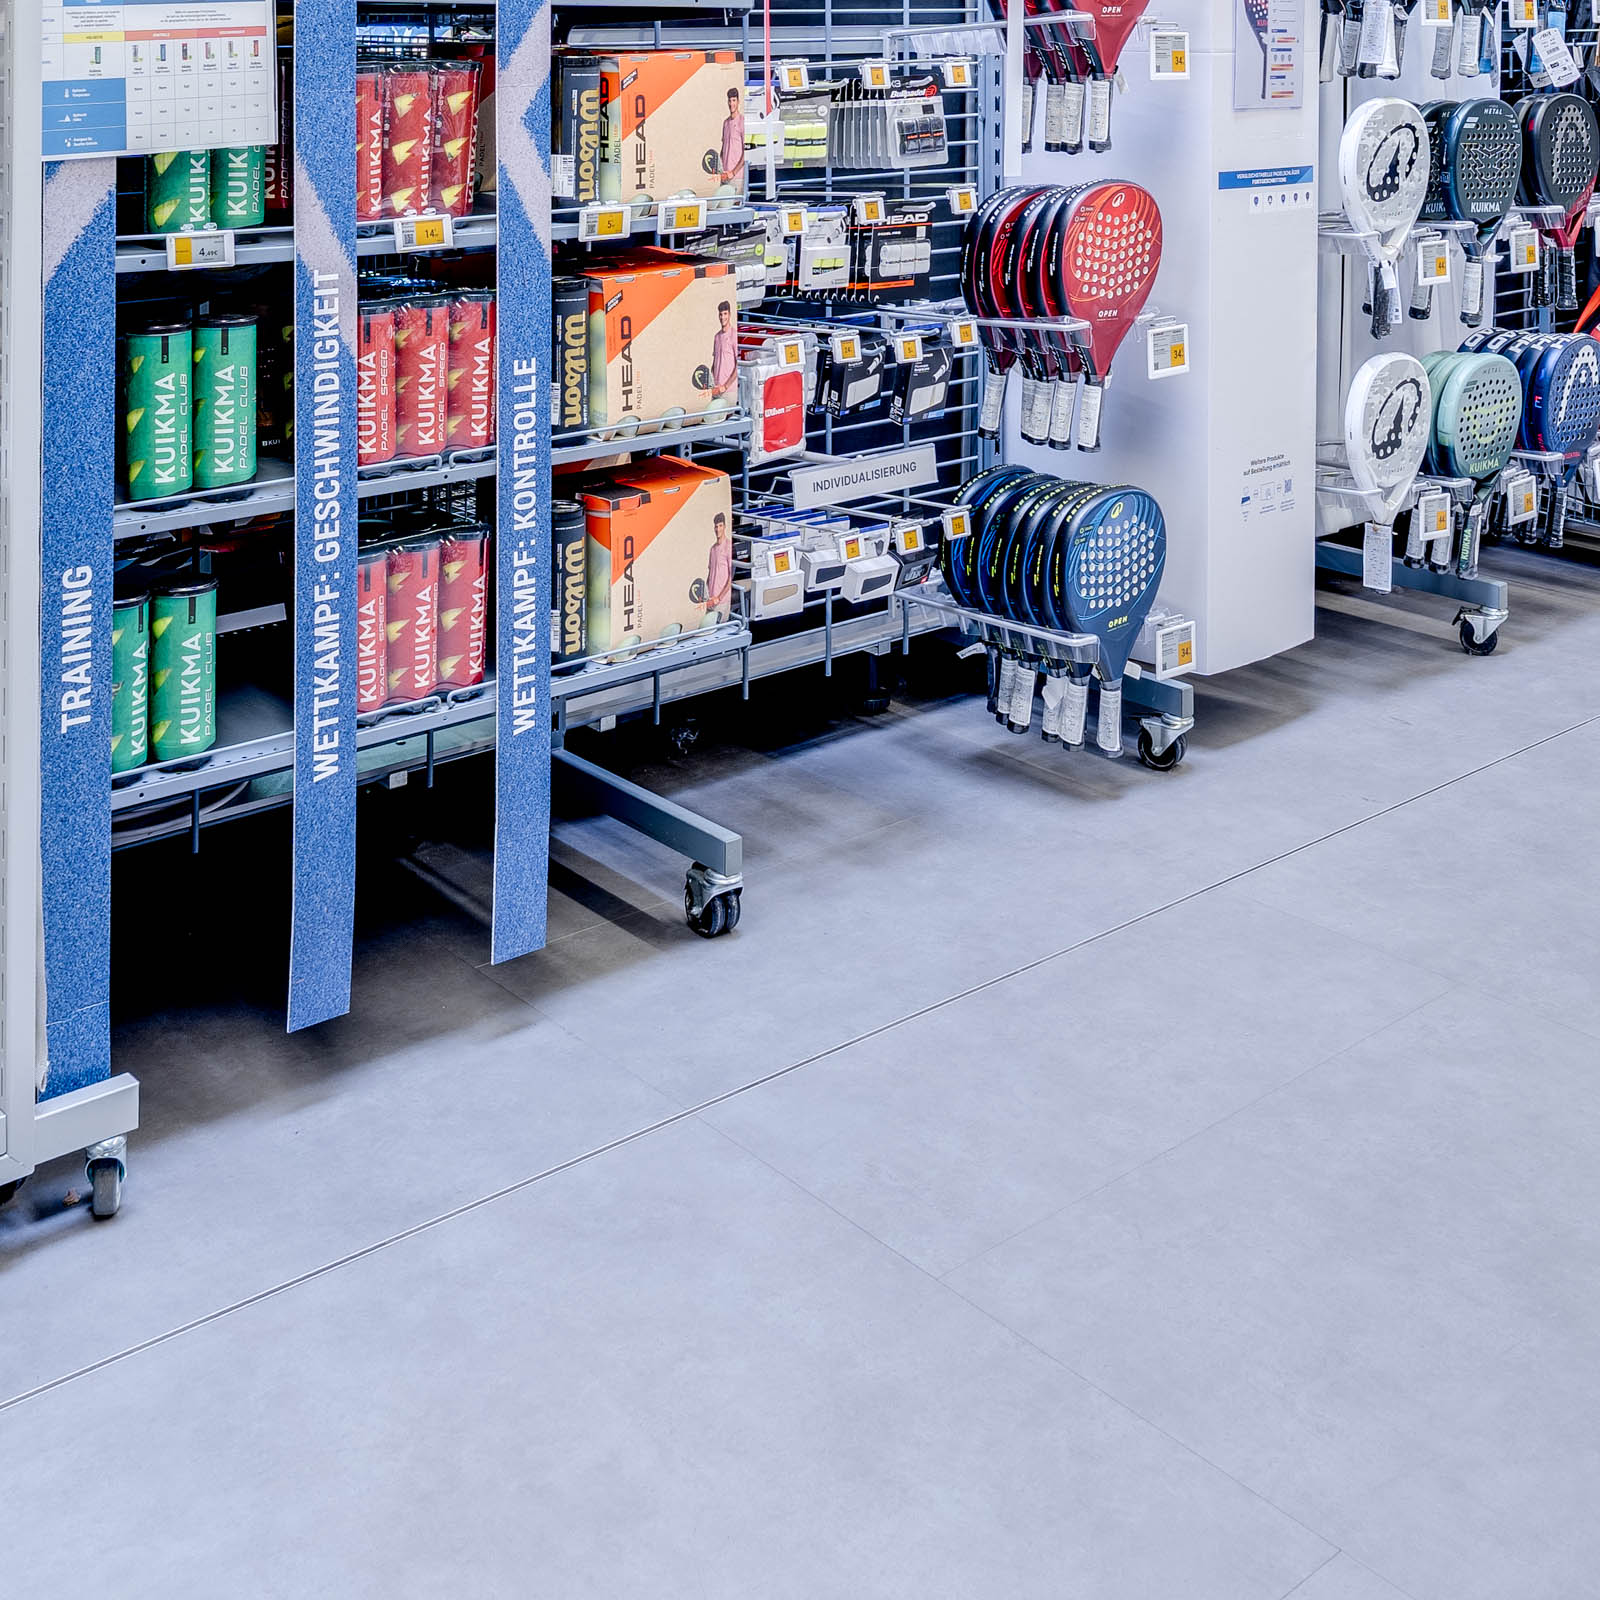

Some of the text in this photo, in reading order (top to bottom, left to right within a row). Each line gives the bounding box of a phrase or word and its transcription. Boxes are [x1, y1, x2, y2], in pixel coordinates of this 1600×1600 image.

[1102, 6, 1122, 14] OPEN
[600, 77, 610, 164] HEAD
[635, 93, 647, 191] HEAD
[890, 88, 925, 99] Bullpadel
[1484, 108, 1503, 116] METAL
[252, 167, 260, 213] PADEL
[879, 213, 929, 224] HEAD
[1470, 202, 1501, 213] KUIKMA
[1098, 309, 1118, 318] OPEN
[180, 373, 188, 417] CLUB
[359, 351, 377, 454] KUIKMA
[380, 349, 388, 451] PADEL SPEED
[418, 343, 437, 446] KUIKMA
[471, 336, 490, 437] KUIKMA
[563, 310, 587, 429] Wilson
[621, 315, 633, 413] HEAD
[764, 407, 785, 418] Wilson
[155, 372, 176, 485] KUIKMA
[214, 364, 235, 473] KUIKMA
[240, 366, 249, 469] PADEL CLUB
[1469, 460, 1500, 474] KUIKMA
[312, 269, 340, 784] WETTKAMPF: GESCHWINDIGKEIT
[812, 461, 917, 492] INDIVIDUALISIERUNG
[512, 356, 537, 737] WETTKAMPF: KONTROLLE
[565, 536, 586, 656] Wilson
[624, 535, 636, 633] HEAD
[61, 565, 93, 734] TRAINING
[360, 597, 376, 703] KUIKMA
[414, 583, 432, 689] KUIKMA
[470, 577, 487, 676] KUIKMA
[1108, 615, 1128, 628] OPEN
[131, 640, 147, 757] KUIKMA
[180, 631, 201, 745] KUIKMA
[205, 633, 213, 736] PADEL CLUB
